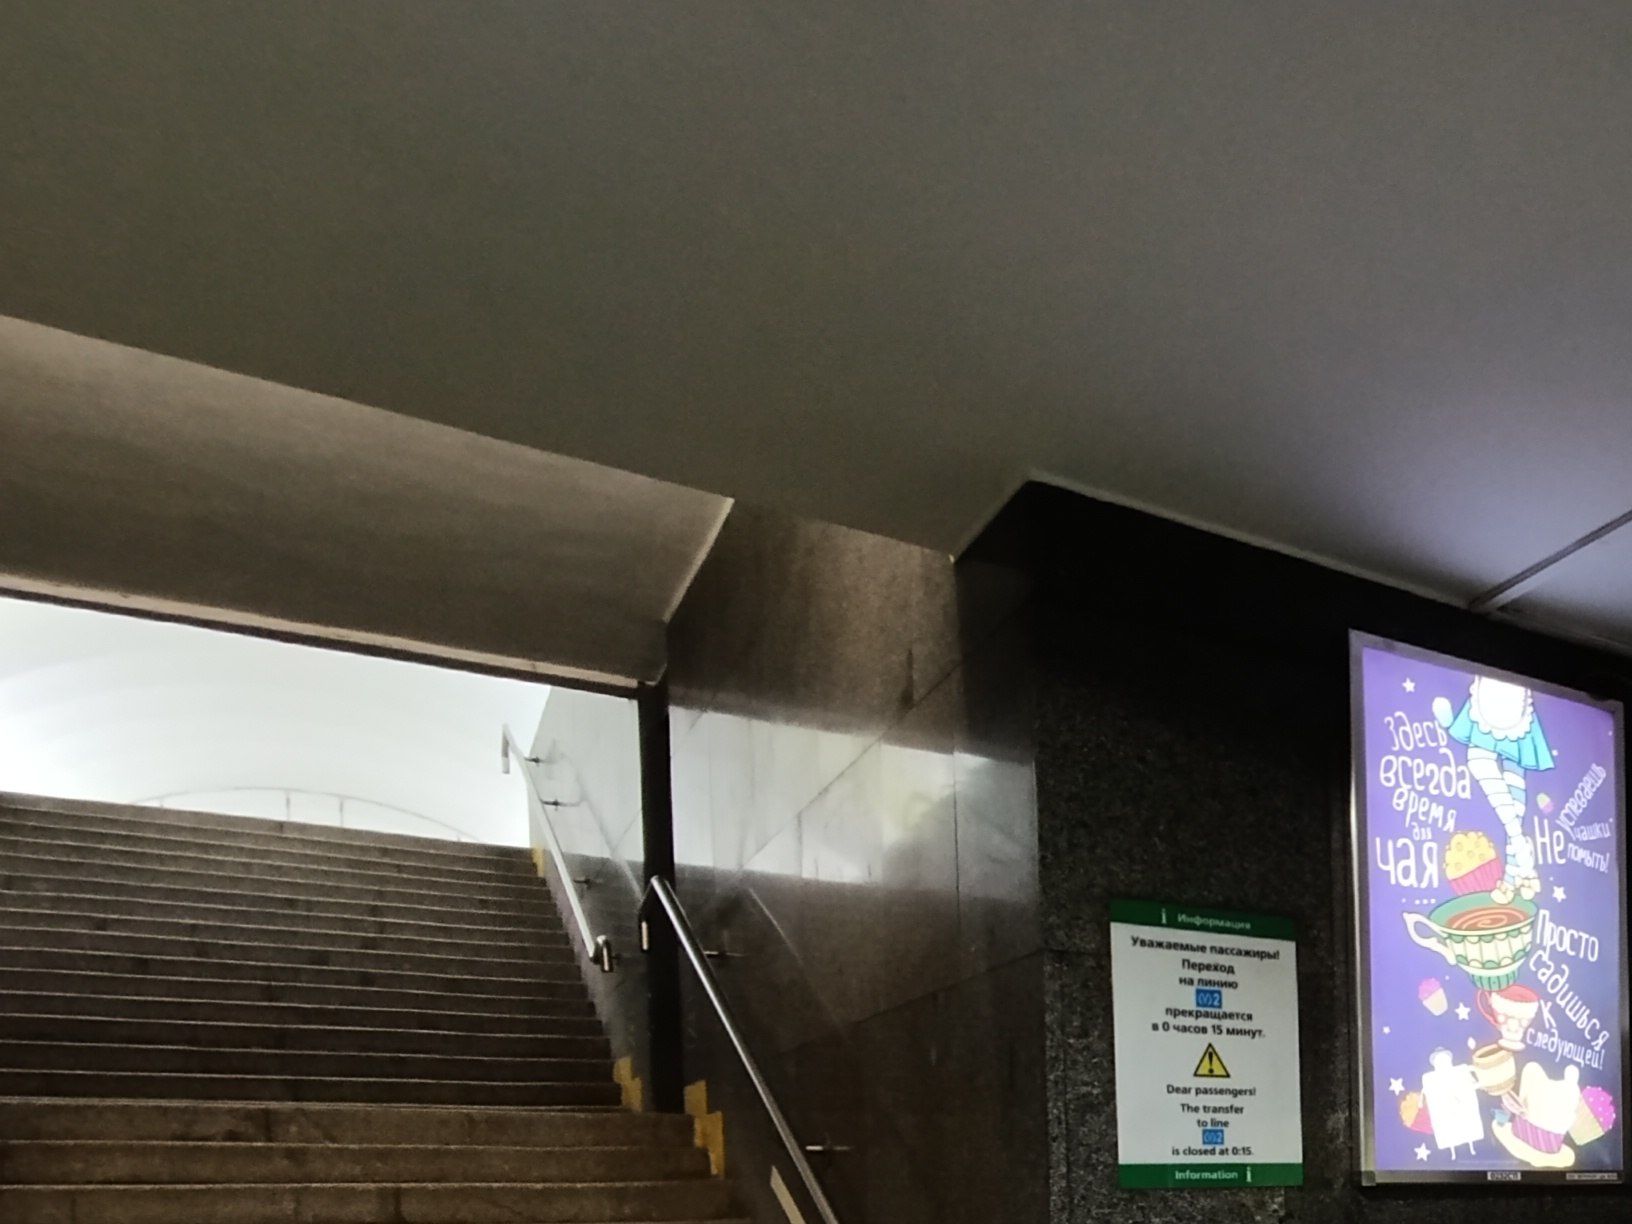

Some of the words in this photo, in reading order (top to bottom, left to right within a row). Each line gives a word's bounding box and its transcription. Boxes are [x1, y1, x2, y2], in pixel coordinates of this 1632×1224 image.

[1384, 711, 1448, 751] Здесь
[1380, 747, 1472, 799] всегда
[1392, 787, 1457, 832] время
[1533, 815, 1566, 864] Не
[1177, 913, 1251, 930] Информация
[1536, 909, 1599, 962] Просто
[1131, 936, 1207, 954] Уважаемые
[1210, 945, 1280, 961] пассажиры!
[1182, 959, 1235, 975] Переход
[1179, 977, 1194, 986] на
[1197, 978, 1238, 990] линию
[1529, 949, 1609, 1051] садишься
[1165, 1007, 1253, 1022] прекращается
[1173, 1024, 1207, 1035] часов
[1211, 1023, 1223, 1035] 15
[1166, 1085, 1192, 1095] Dear
[1195, 1086, 1256, 1098] passengers!
[1180, 1103, 1200, 1114] The
[1203, 1104, 1244, 1115] transfer
[1197, 1118, 1207, 1128] to
[1211, 1118, 1229, 1128] line
[1172, 1146, 1180, 1156] is
[1183, 1146, 1216, 1156] closed
[1219, 1147, 1229, 1156] at
[1175, 1170, 1238, 1181] Information
